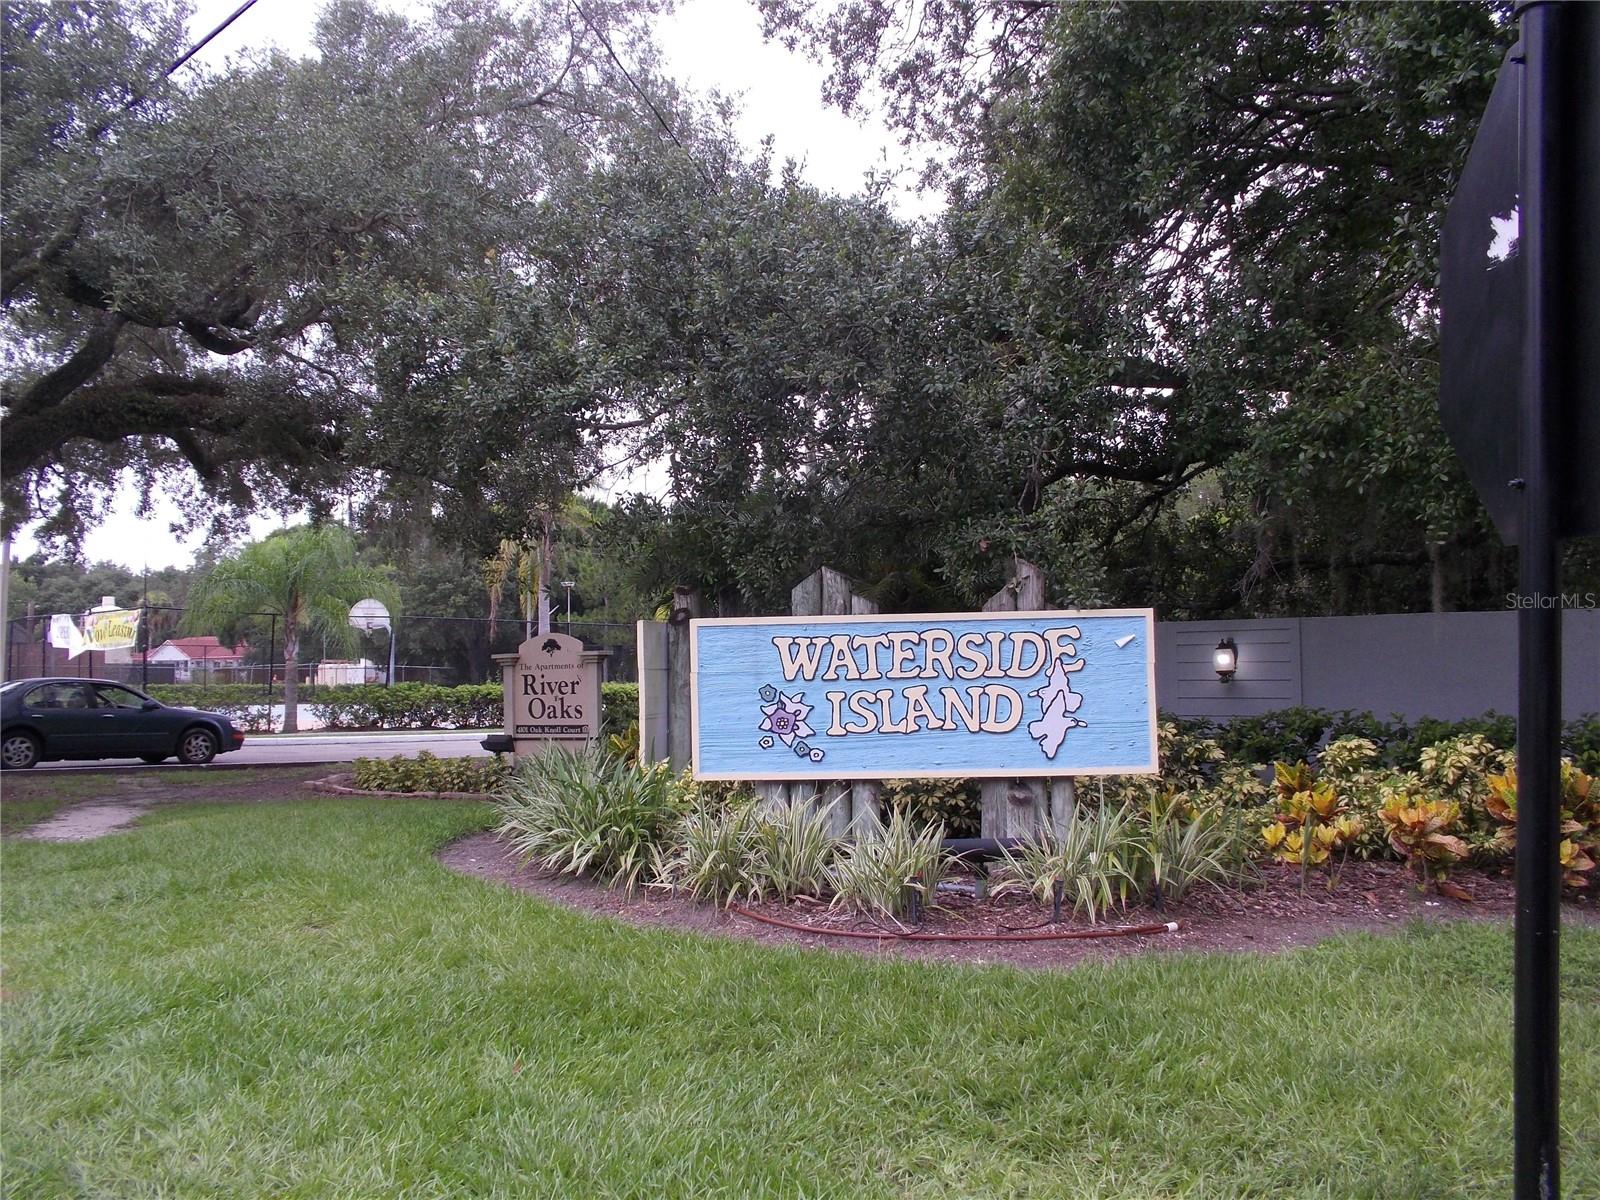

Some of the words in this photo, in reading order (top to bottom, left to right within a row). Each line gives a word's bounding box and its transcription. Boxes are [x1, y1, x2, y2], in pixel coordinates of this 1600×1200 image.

[772, 626, 1085, 681] WATERSIDE
[519, 663, 533, 671] The
[535, 663, 574, 671] Apartments
[521, 673, 580, 695] River
[528, 697, 583, 720] Oaks
[825, 684, 1024, 736] ISLAND
